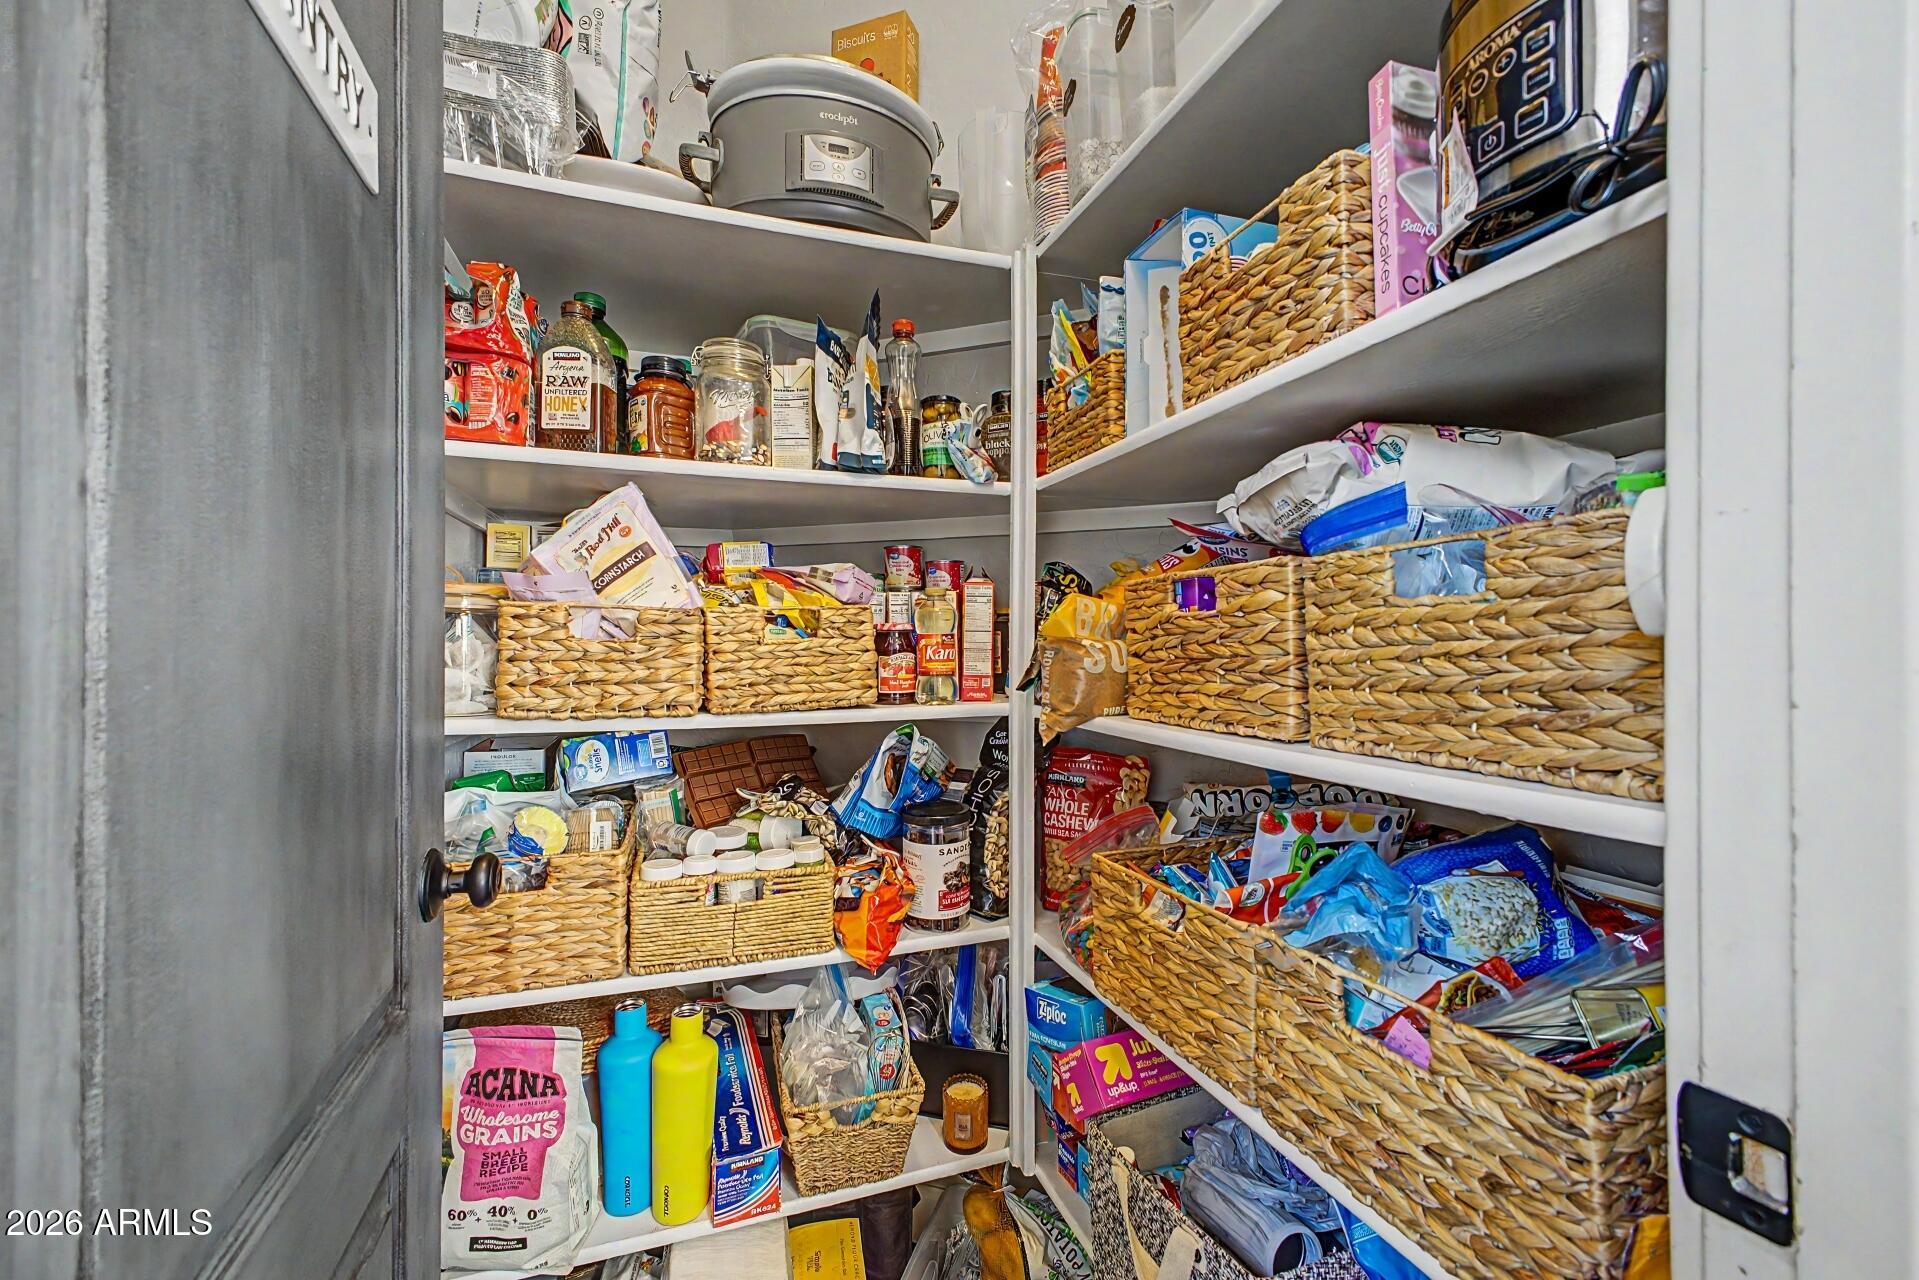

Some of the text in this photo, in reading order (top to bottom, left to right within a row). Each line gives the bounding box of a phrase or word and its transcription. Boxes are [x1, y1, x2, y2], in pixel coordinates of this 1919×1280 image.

[837, 31, 876, 51] Biscuits
[1373, 142, 1391, 193] just
[1379, 194, 1391, 294] cupcakes
[544, 388, 588, 396] UNFILTERED
[544, 396, 588, 412] HONEY
[593, 550, 646, 591] CORNSTARCH
[926, 646, 956, 661] Karo
[1047, 773, 1085, 783] KIRKLAND
[1044, 797, 1090, 817] WHOLE
[1043, 811, 1101, 833] CASHEW
[1038, 999, 1067, 1025] Ziploc
[464, 1067, 561, 1102] ACANA
[460, 1105, 560, 1127] Wholesome
[460, 1120, 558, 1147] GRAINS
[480, 1154, 528, 1170] BREED
[482, 1147, 528, 1161] SMALL
[479, 1162, 529, 1178] RECIPE
[447, 1205, 549, 1222] 60% 40% 0%
